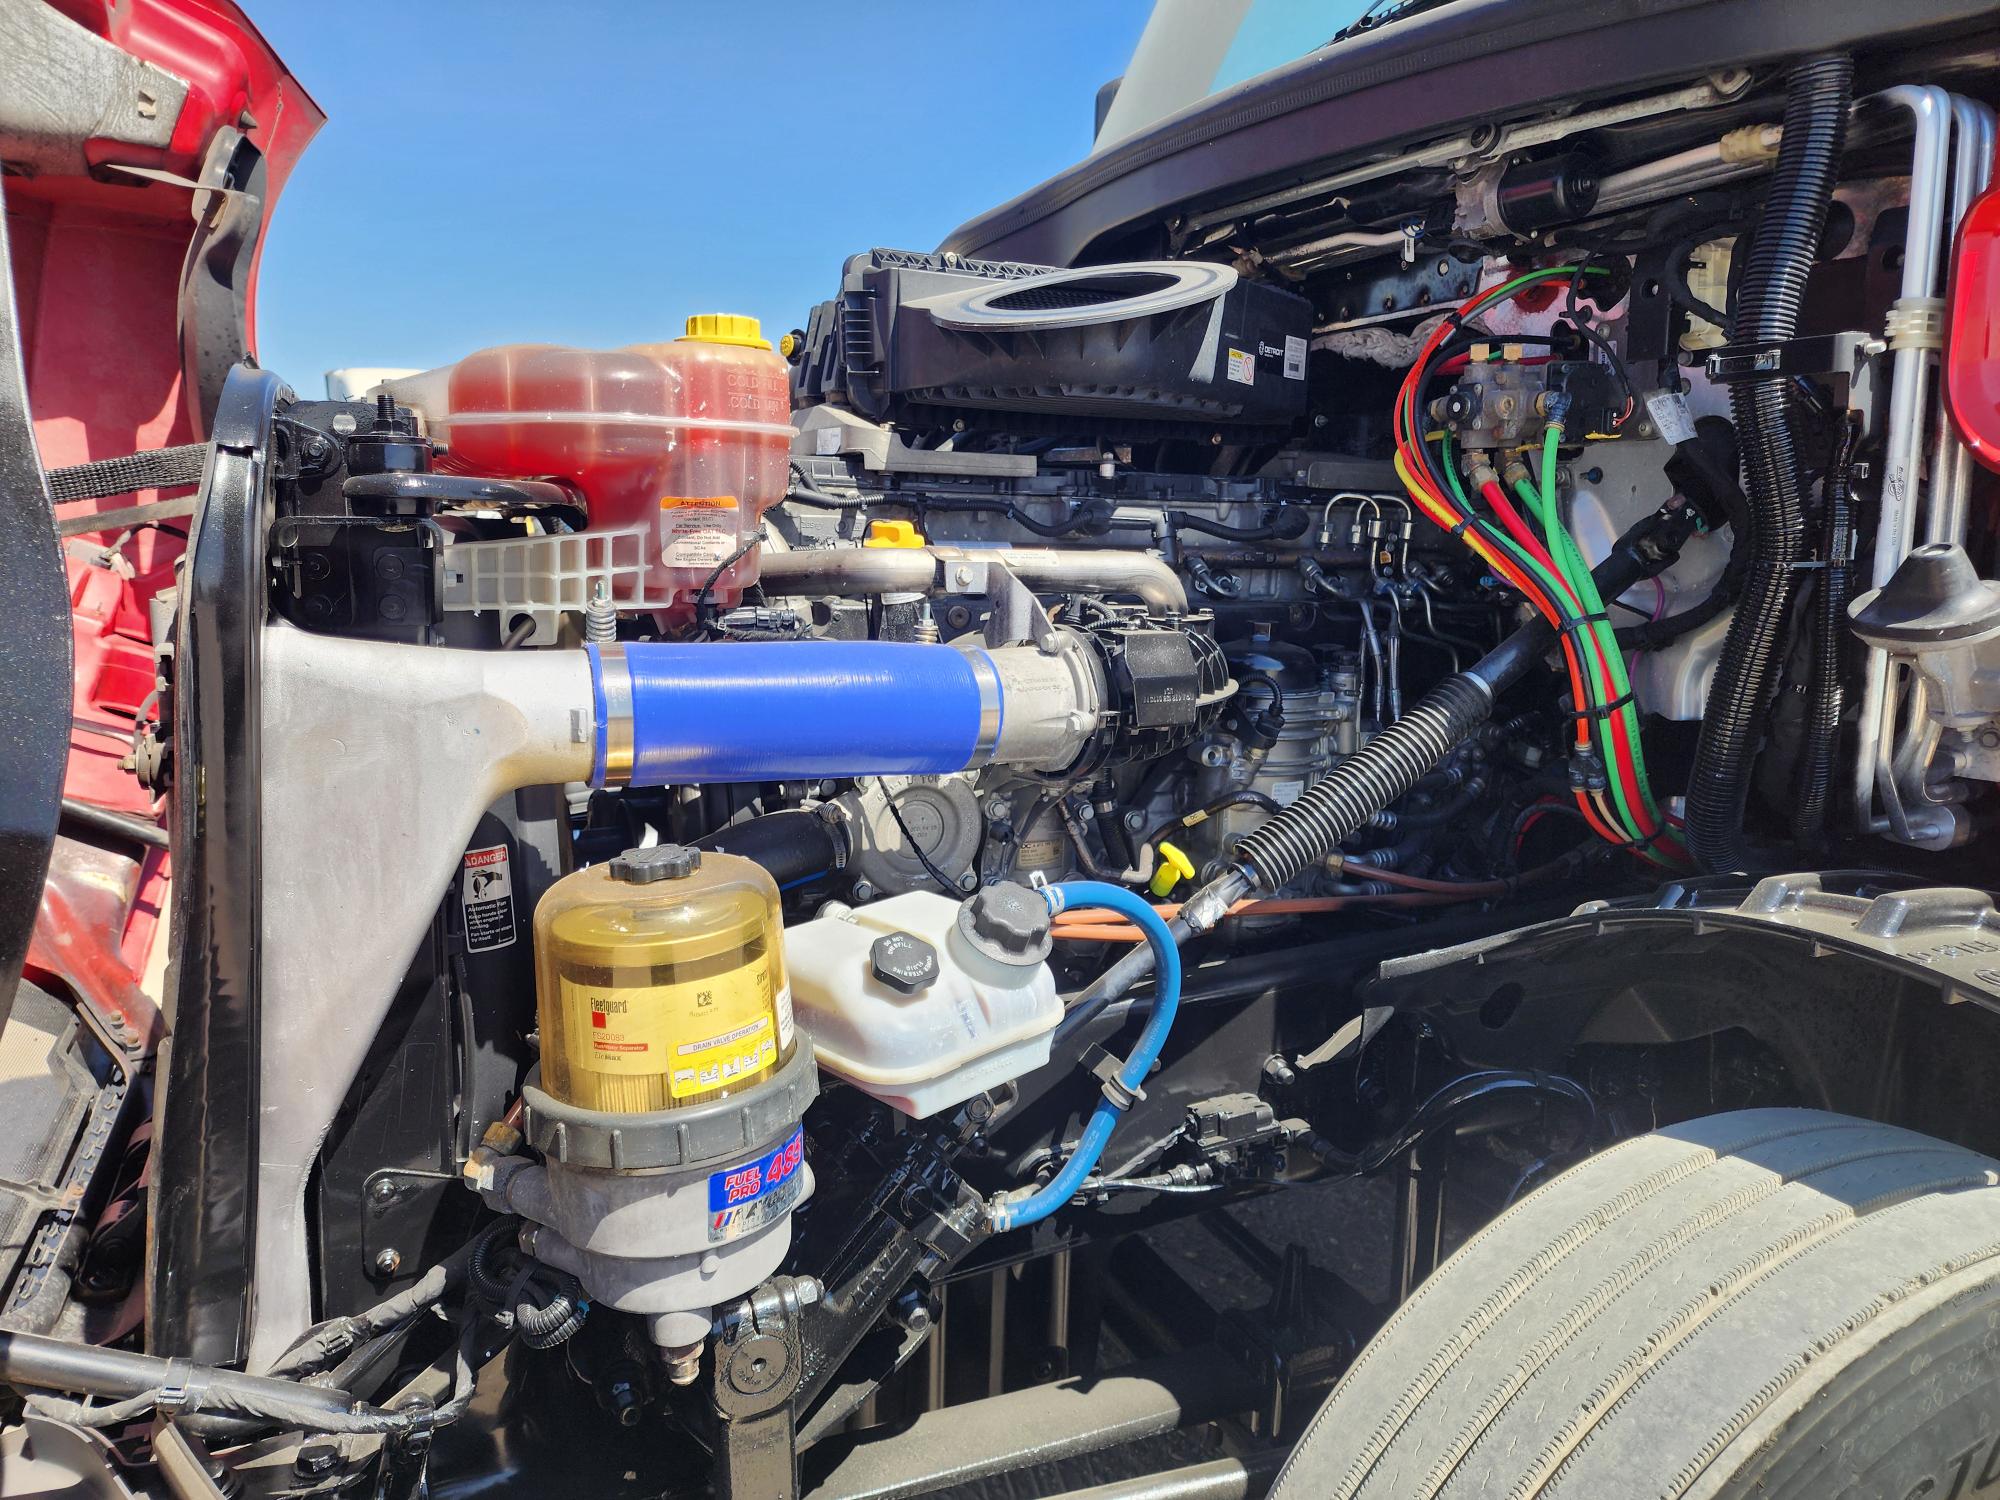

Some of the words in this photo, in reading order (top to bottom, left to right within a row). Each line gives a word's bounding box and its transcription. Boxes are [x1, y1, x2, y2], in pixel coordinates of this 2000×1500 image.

[1264, 346, 1284, 357] DETROIT
[470, 851, 507, 866] DANGER
[467, 902, 497, 913] Automatic
[481, 911, 497, 919] hands
[482, 916, 499, 925] engine
[883, 939, 892, 947] DO
[887, 942, 913, 955] OVERFILL
[892, 966, 924, 977] STEERING
[905, 961, 924, 971] FLUID
[590, 997, 627, 1016] Fleetguard
[692, 1041, 712, 1051] DRAIN
[713, 1035, 730, 1046] VALVE
[731, 1023, 759, 1041] OPERATION
[724, 1166, 762, 1191] FUEL
[727, 1179, 761, 1204] PRO
